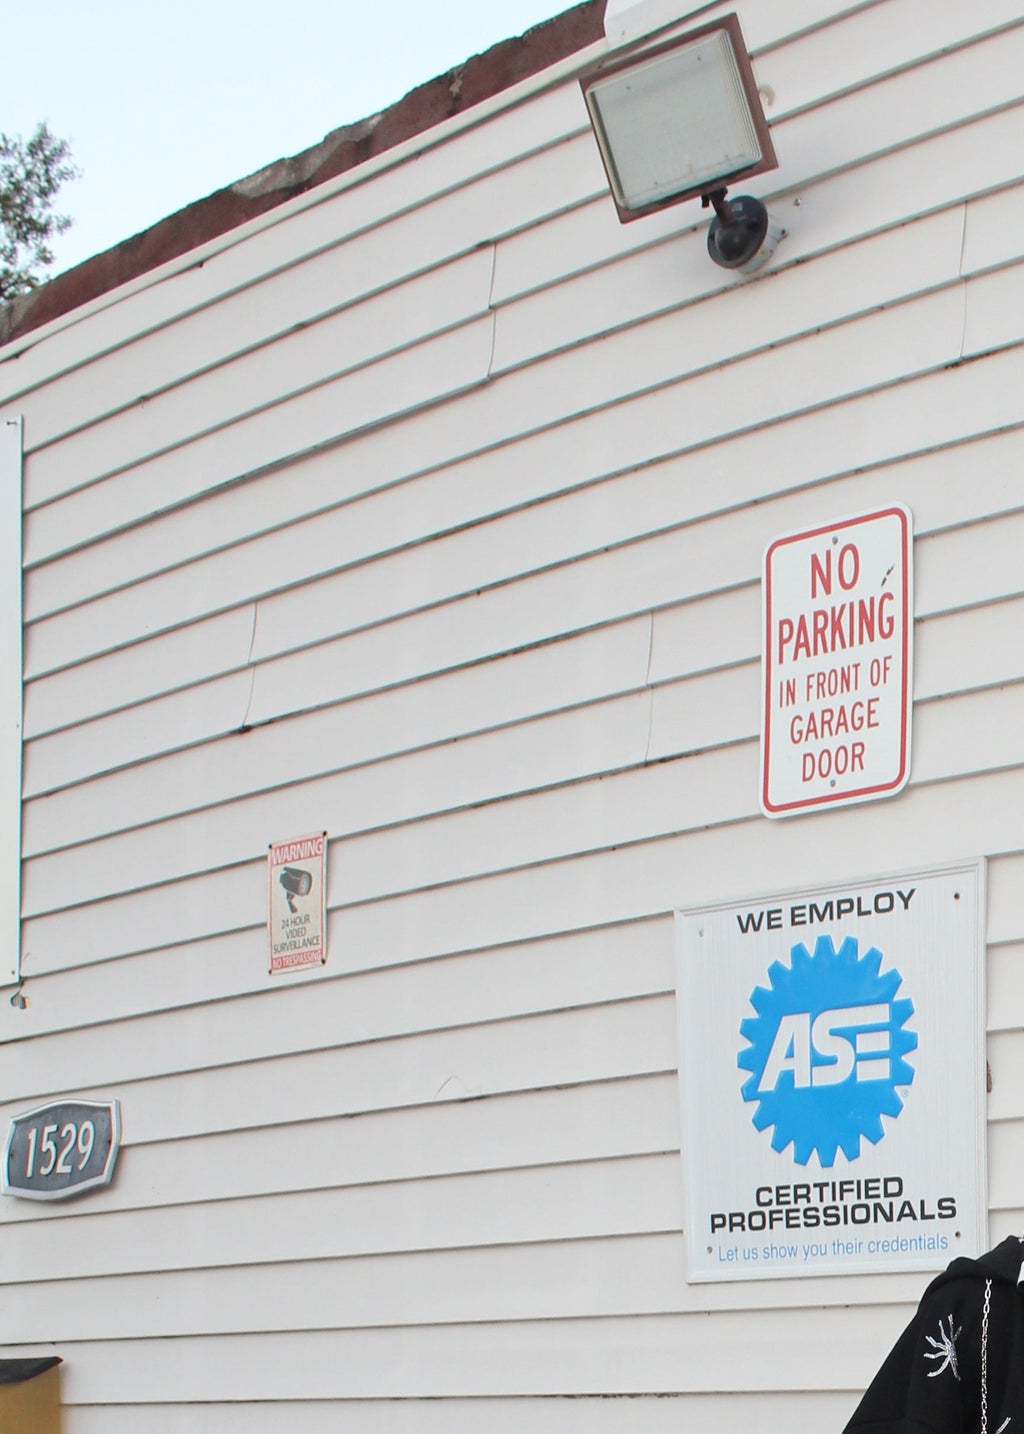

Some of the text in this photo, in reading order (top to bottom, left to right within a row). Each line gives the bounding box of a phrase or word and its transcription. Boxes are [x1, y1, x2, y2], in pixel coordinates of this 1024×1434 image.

[810, 543, 860, 599] NO
[778, 592, 894, 665] PARKING
[779, 655, 893, 708] IN FRONT OF
[790, 697, 880, 744] GARAGE
[802, 741, 865, 783] DOOR
[272, 838, 323, 865] WARNING
[281, 914, 310, 929] 24 HOUR
[737, 888, 917, 934] WE EMPLOY
[273, 935, 321, 955] SURVEILLANCE
[285, 927, 307, 939] VIDEO
[272, 950, 322, 969] NO TRESPASSING
[757, 1003, 890, 1093] ASE
[26, 1120, 95, 1178] 1529
[756, 1176, 904, 1207] CERTIFIED
[710, 1197, 957, 1234] PROFESSIONALS
[719, 1233, 948, 1262] Let us show you their credentials
